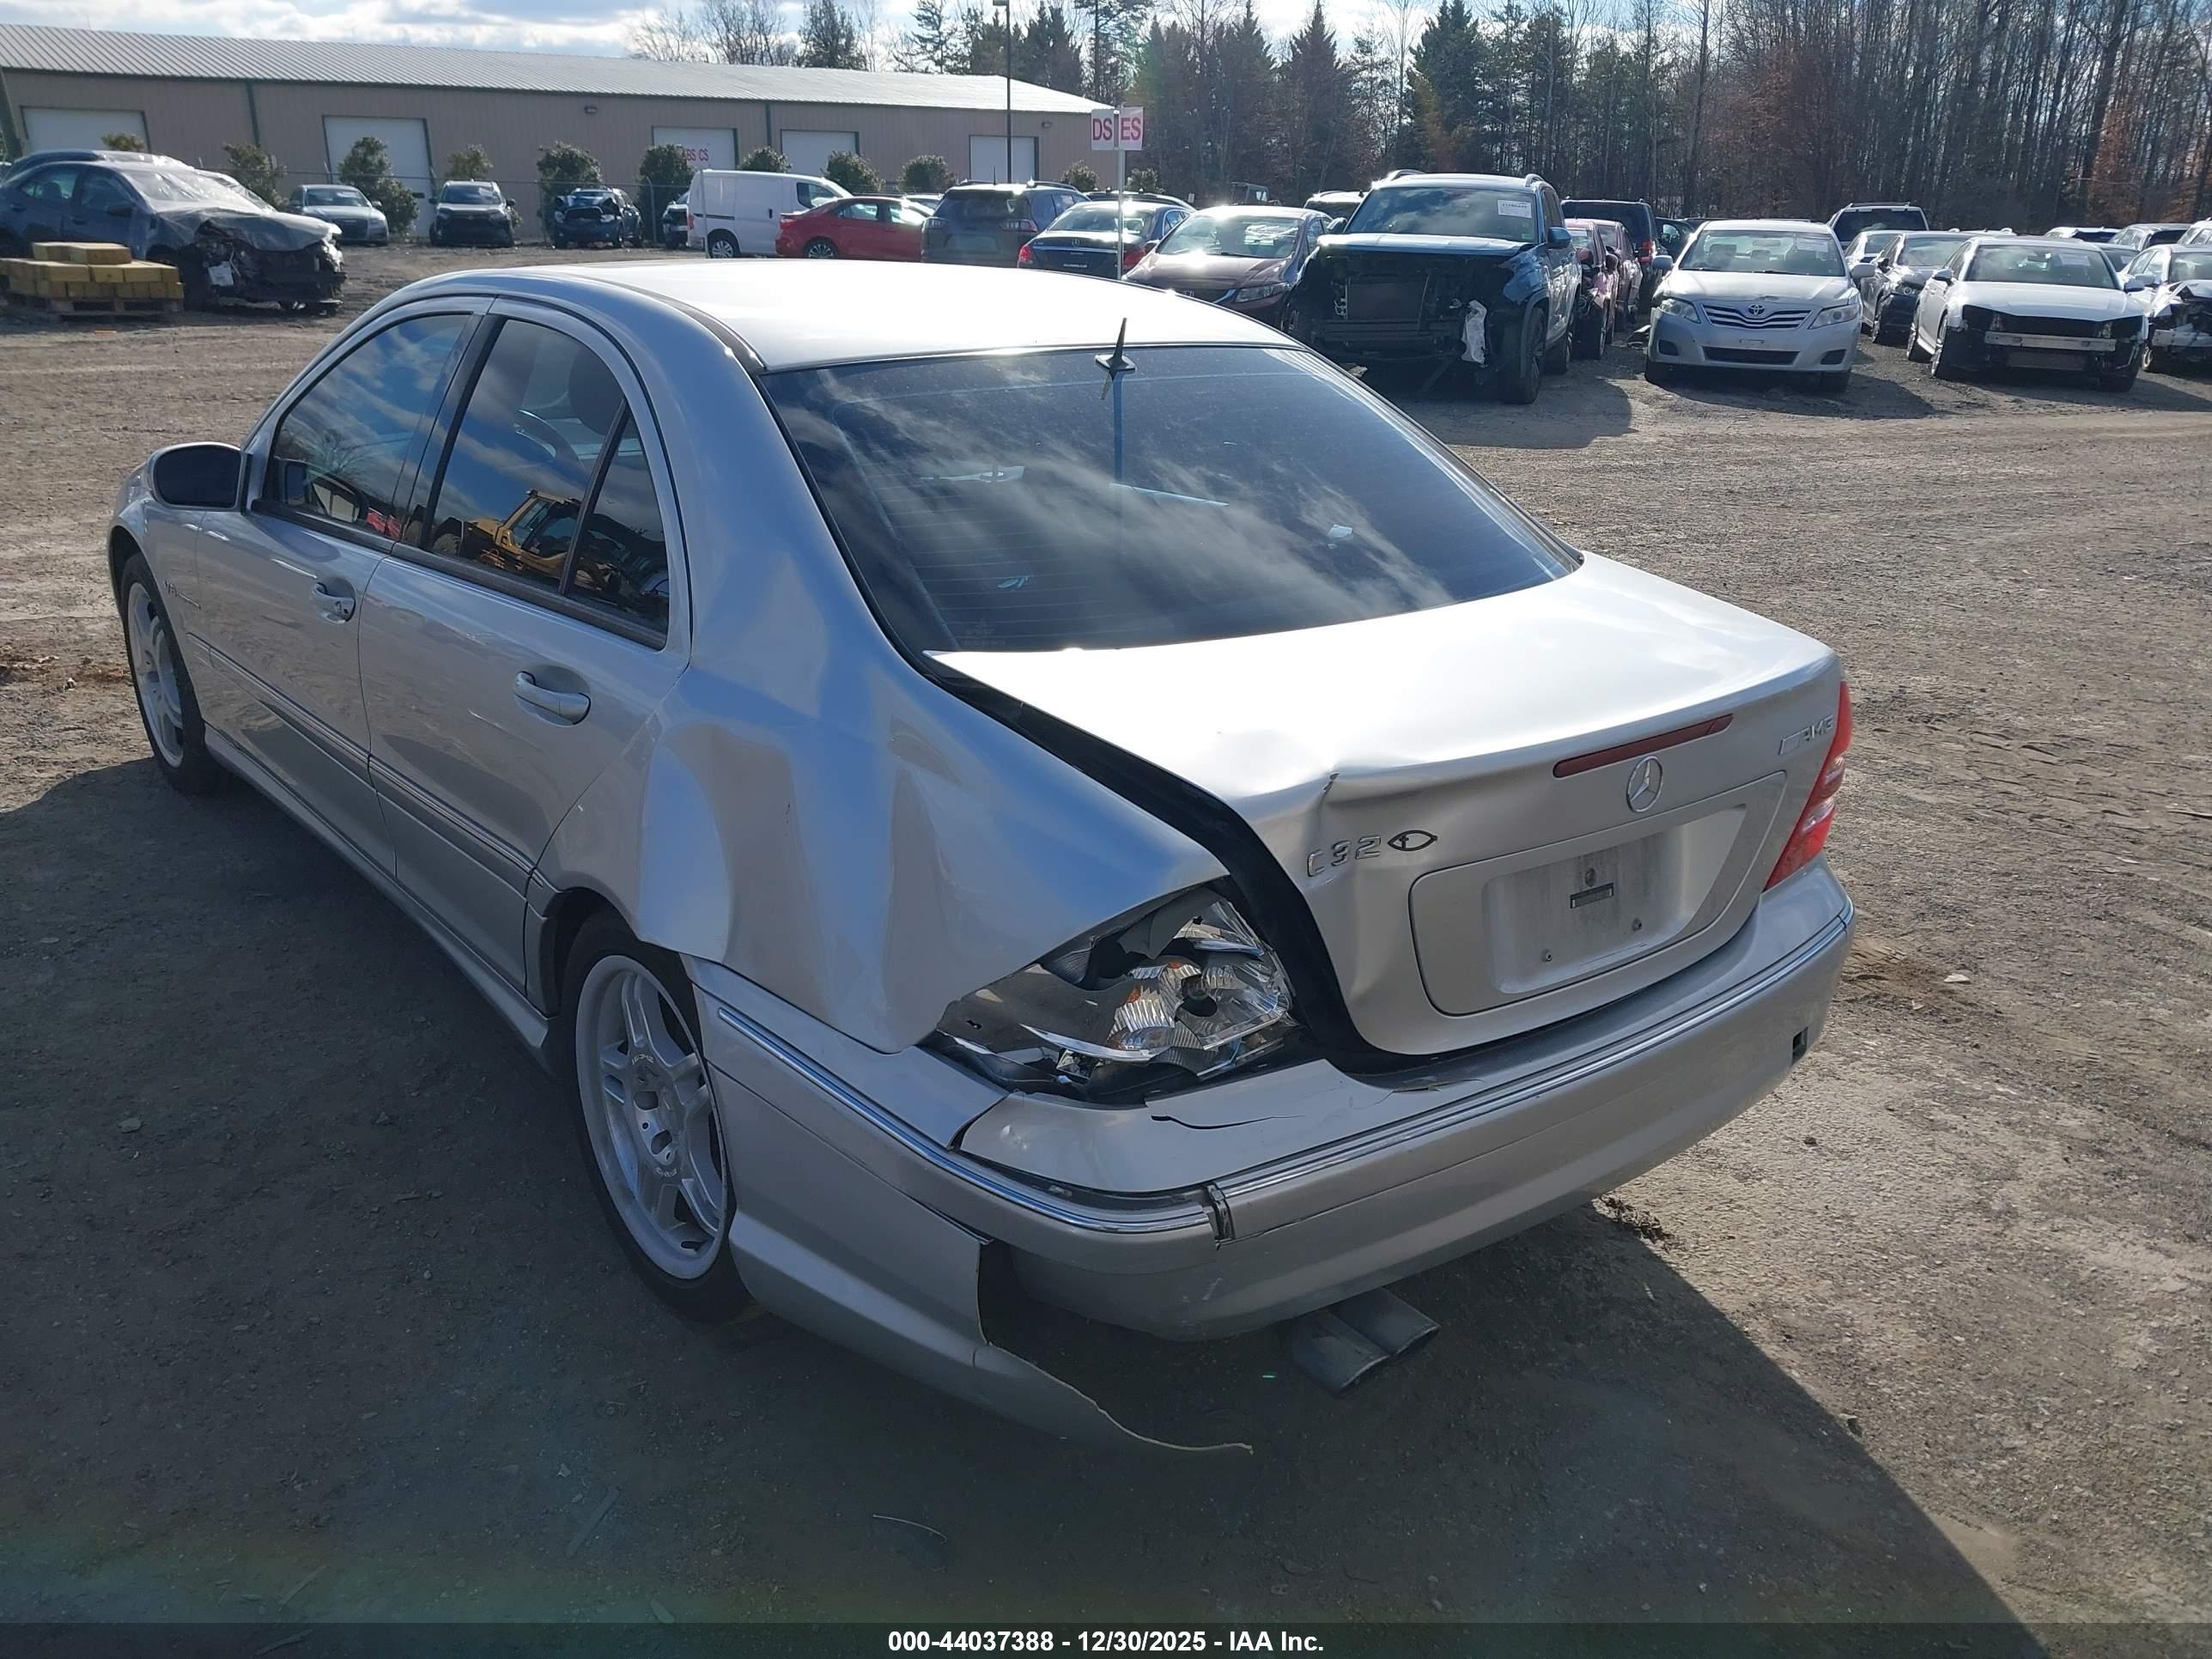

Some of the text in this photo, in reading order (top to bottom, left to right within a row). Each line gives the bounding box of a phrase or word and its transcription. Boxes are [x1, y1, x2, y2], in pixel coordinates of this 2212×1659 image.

[1092, 118, 1113, 141] DS
[1121, 117, 1141, 141] ES
[699, 148, 709, 161] CS
